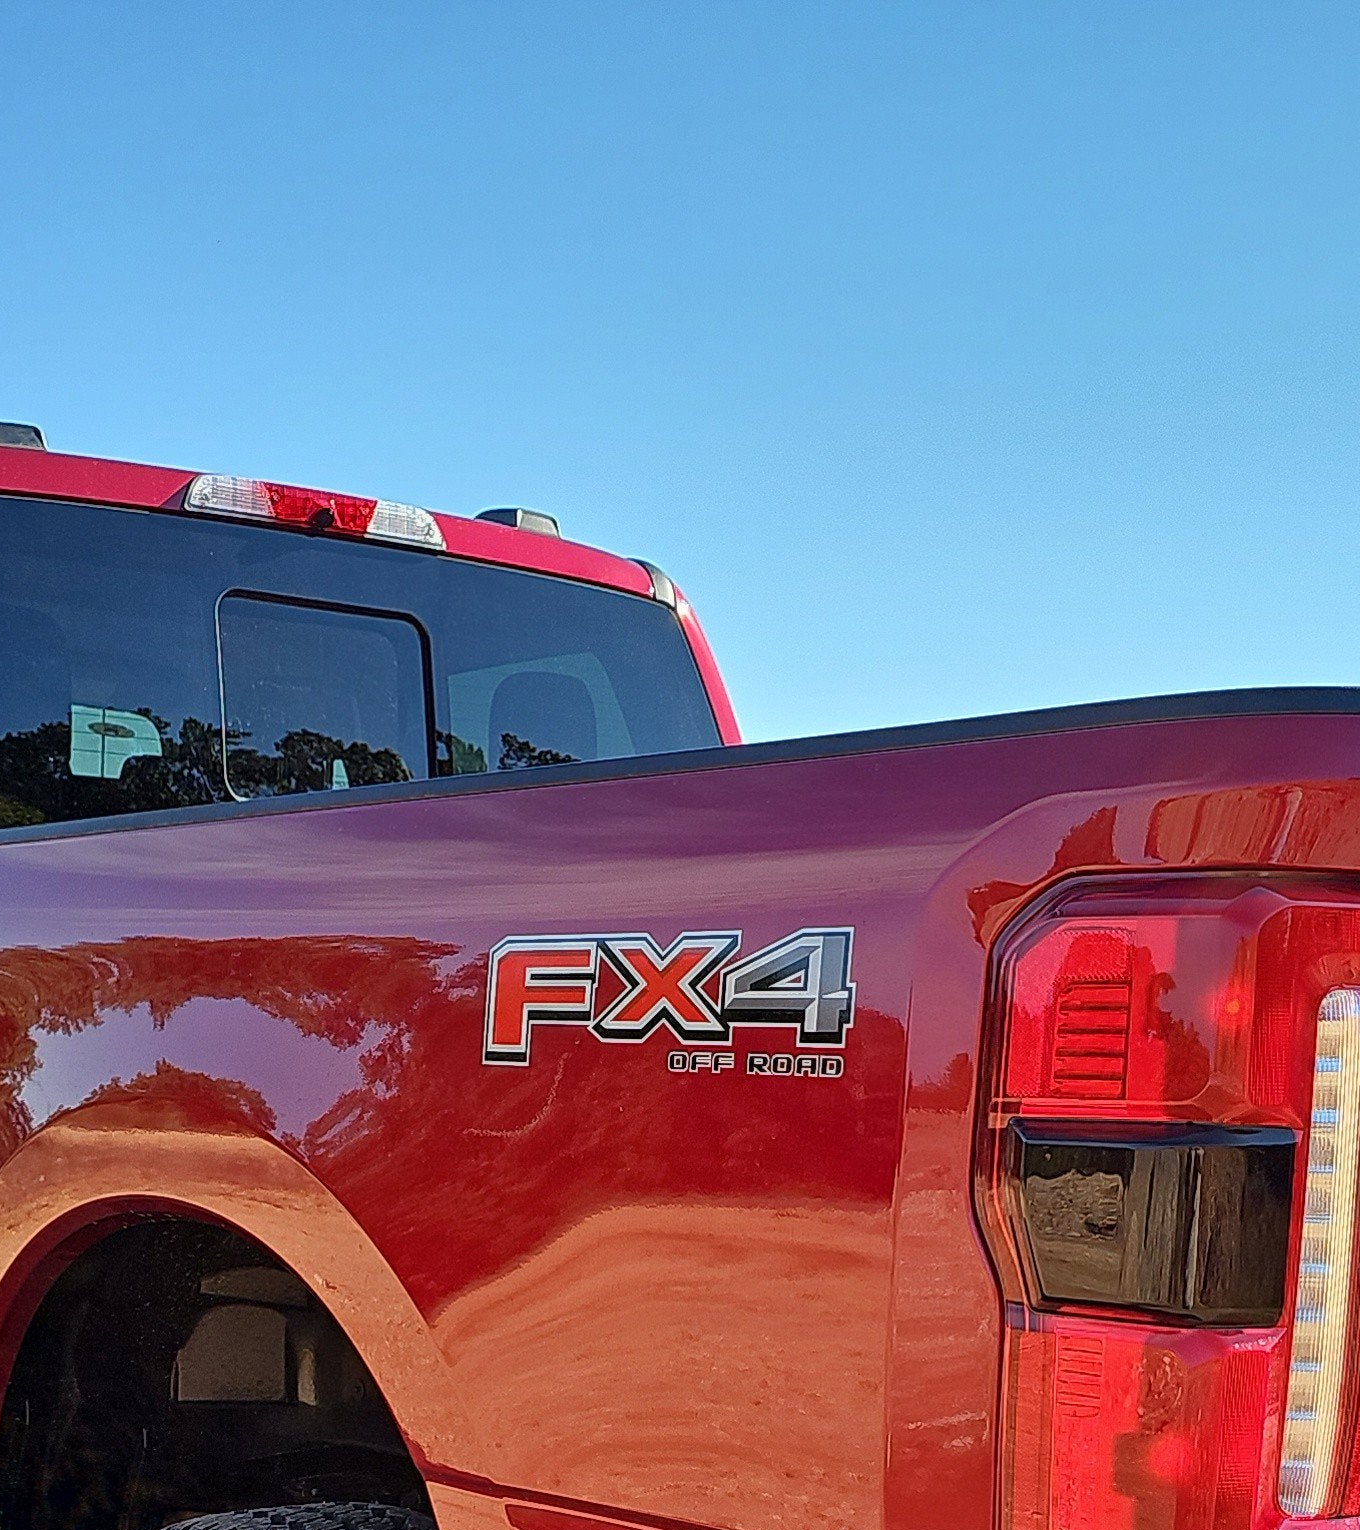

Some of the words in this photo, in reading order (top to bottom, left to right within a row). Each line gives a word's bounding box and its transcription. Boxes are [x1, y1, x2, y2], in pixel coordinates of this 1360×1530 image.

[482, 926, 856, 1066] FX4
[667, 1050, 736, 1075] OFF
[746, 1052, 845, 1079] ROAD
